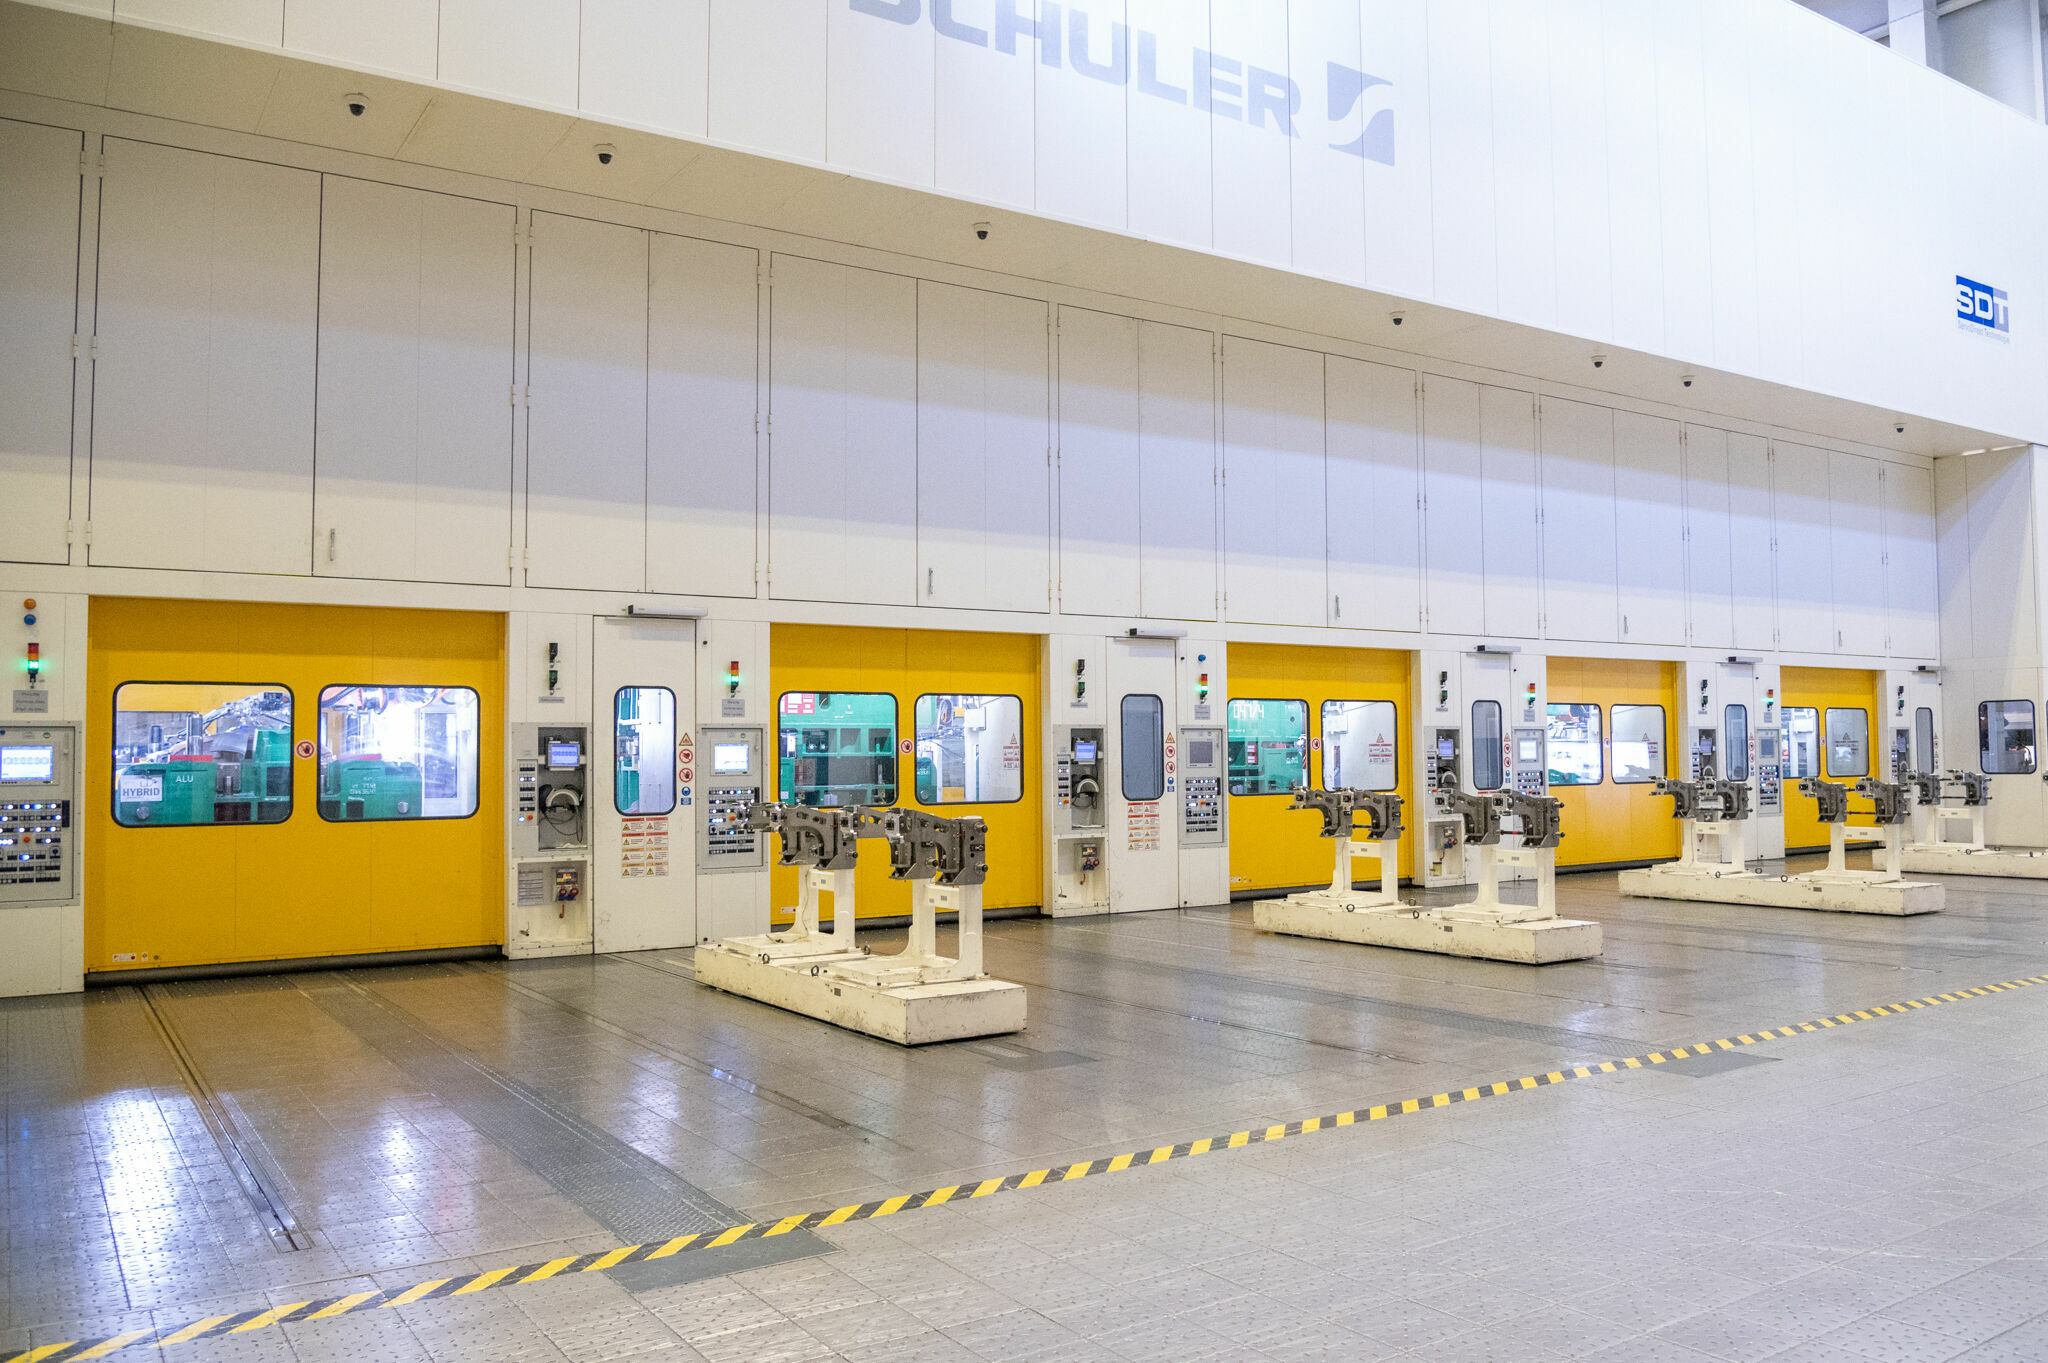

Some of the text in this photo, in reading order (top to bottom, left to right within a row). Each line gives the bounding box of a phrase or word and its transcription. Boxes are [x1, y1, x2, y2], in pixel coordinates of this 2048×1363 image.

[1956, 283, 2009, 325] SDT
[175, 775, 194, 783] ALU
[122, 787, 160, 797] HYBRID
